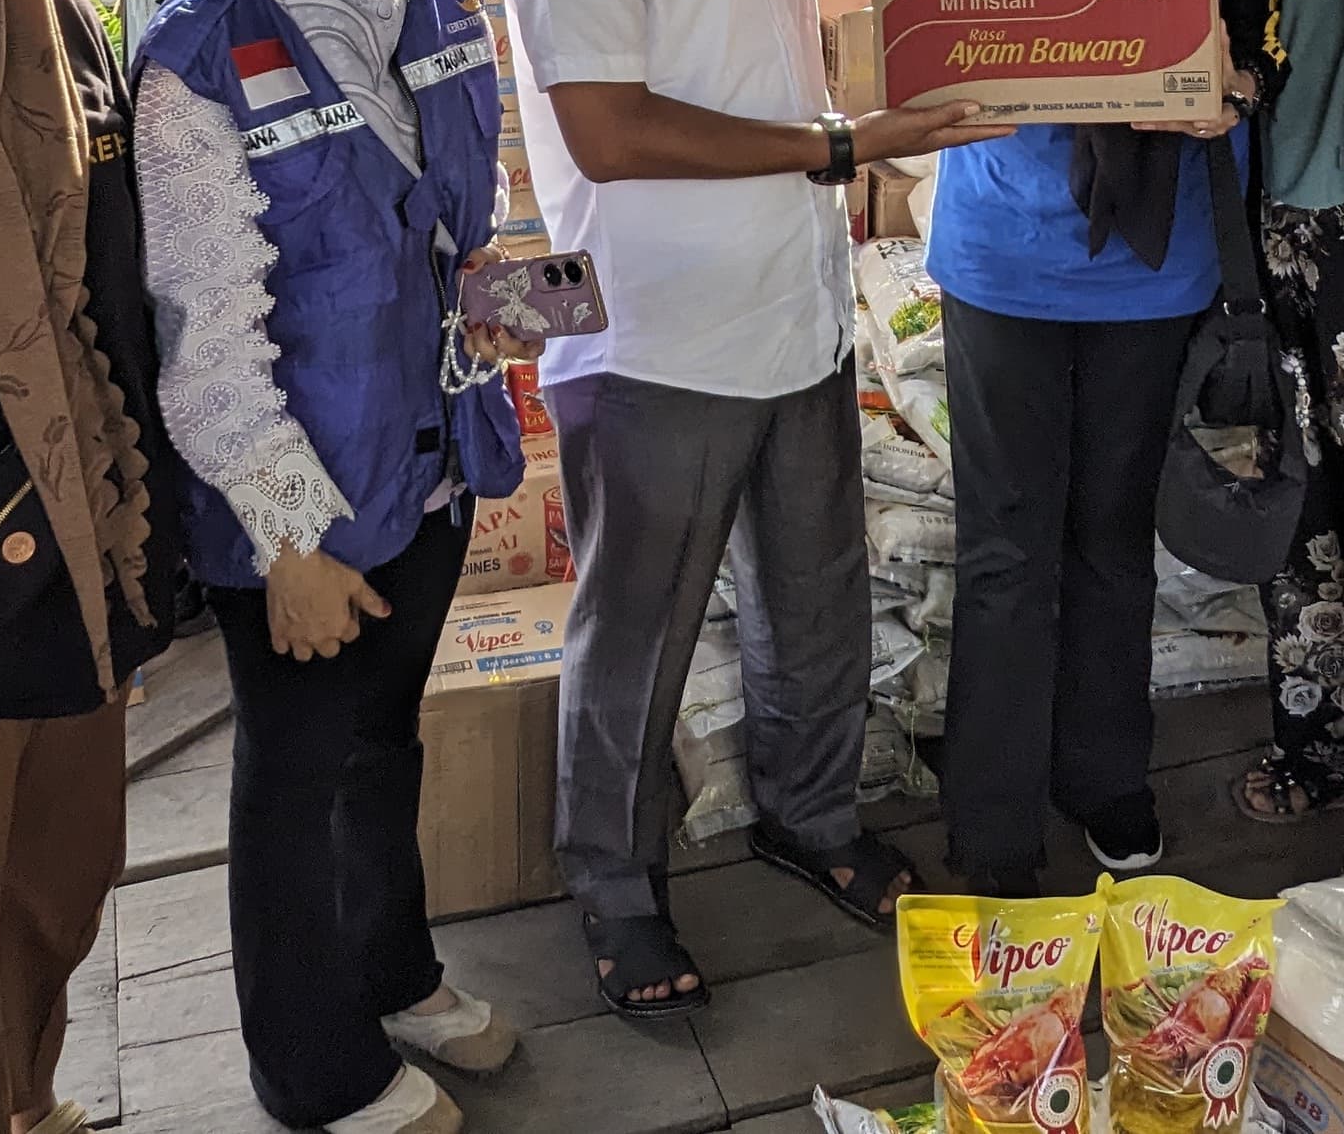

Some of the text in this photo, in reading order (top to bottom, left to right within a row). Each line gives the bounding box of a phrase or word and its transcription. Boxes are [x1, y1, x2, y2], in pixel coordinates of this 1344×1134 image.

[969, 28, 1006, 42] Rasa
[946, 37, 1146, 73] Ayam Bawang
[1180, 76, 1209, 84] HALAL
[1033, 102, 1065, 111] SUKSES
[1066, 101, 1104, 111] MAKMUR
[883, 443, 926, 459] INDONESIA
[456, 630, 526, 653] Vipco
[1134, 898, 1230, 967] Vipco
[953, 918, 1068, 988] Vipco
[1294, 1090, 1323, 1123] 88
